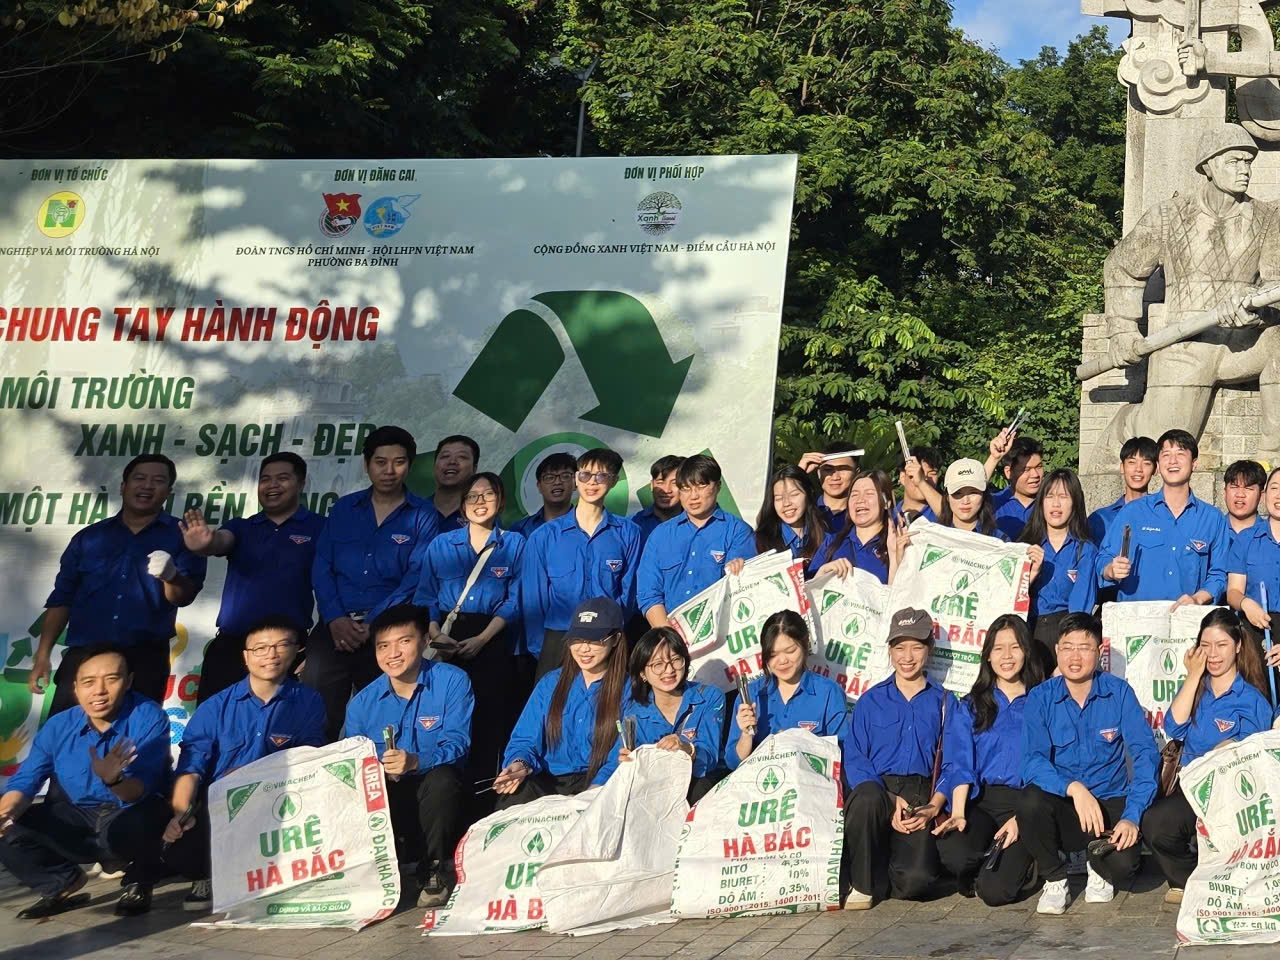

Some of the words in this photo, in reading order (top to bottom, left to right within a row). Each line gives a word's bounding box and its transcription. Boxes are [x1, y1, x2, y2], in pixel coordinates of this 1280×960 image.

[31, 167, 52, 182] ĐƠN
[54, 169, 65, 184] VỊ
[67, 166, 80, 181] TỔ
[80, 167, 109, 181] CHỨC
[334, 169, 355, 182] ĐƠN
[358, 170, 367, 184] VỊ
[369, 167, 396, 182] ĐĂNG
[399, 169, 415, 182] CAI
[624, 166, 644, 180] ĐƠN
[648, 167, 657, 182] VỊ
[659, 163, 681, 179] PHỐI
[684, 166, 705, 179] HỢP
[41, 245, 53, 256] VÀ
[55, 245, 77, 256] MÔI
[78, 245, 121, 257] TRƯỜNG
[123, 245, 138, 256] HÀ
[140, 245, 160, 258] NỘI
[236, 244, 267, 256] ĐOÀN
[269, 246, 295, 255] TNCS
[297, 244, 312, 255] HỒ
[315, 245, 333, 255] CHÍ
[335, 246, 364, 255] MINH
[372, 244, 394, 257] HỘI
[394, 246, 423, 255] LHPN
[425, 245, 449, 257] VIỆT
[450, 245, 474, 255] NAM
[533, 244, 563, 256] CỘNG
[565, 242, 596, 254] ĐỒNG
[597, 244, 627, 254] XANH
[629, 243, 653, 255] VIỆT
[654, 243, 679, 253] NAM
[716, 241, 737, 252] CẦU
[739, 241, 754, 252] HÀ
[756, 241, 775, 253] NỘI
[308, 257, 353, 267] PHƯỜNG
[355, 258, 368, 267] BA
[371, 256, 398, 267] ĐÌNH
[113, 307, 175, 342] TAY
[180, 299, 277, 342] HÀNH
[284, 299, 380, 350] ĐỘNG
[0, 370, 61, 410] MÔI
[71, 368, 195, 409] TRƯỜNG
[74, 423, 166, 457] XANH
[195, 423, 285, 464] SẠCH
[0, 486, 62, 534] MỘT
[931, 592, 979, 621] URÊ
[825, 638, 872, 670] URÊ
[756, 751, 797, 762] VINACHEM
[1227, 753, 1260, 769] VINACHEM
[273, 772, 315, 789] VINACHEM
[364, 764, 381, 803] UREA
[737, 788, 798, 828] URÊ
[1235, 793, 1277, 836] URÊ
[527, 814, 570, 824] VINACHEM
[259, 814, 323, 857] URÊ
[723, 832, 755, 859] HÀ
[764, 822, 811, 854] BẮC
[370, 834, 387, 865] ĐẠM
[1226, 840, 1249, 865] HÀ
[247, 861, 283, 892] HÀ
[291, 847, 346, 881] BẮC
[377, 865, 398, 881] HÀ
[720, 874, 760, 889] BIURET
[779, 883, 810, 896] 0,35%
[485, 894, 518, 921] HÀ
[706, 906, 722, 915] ISO
[1196, 909, 1210, 917] ISO
